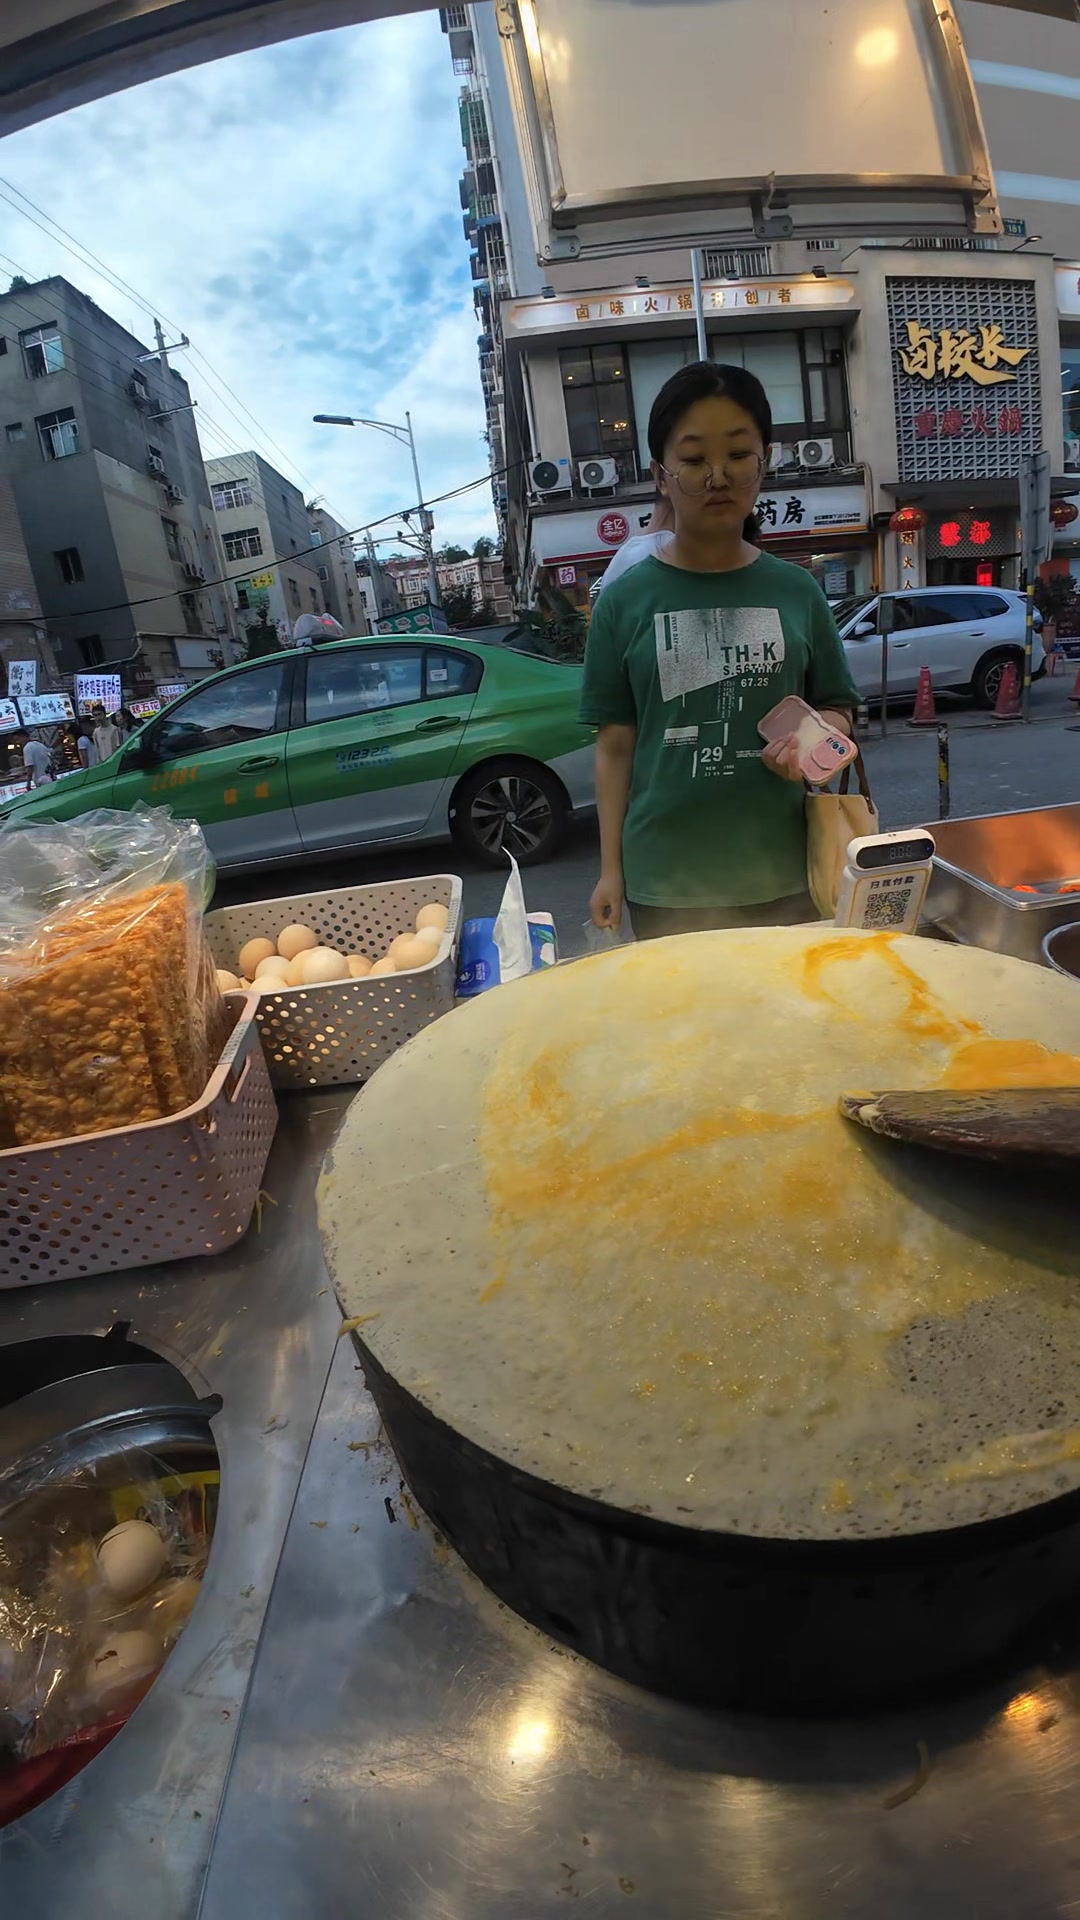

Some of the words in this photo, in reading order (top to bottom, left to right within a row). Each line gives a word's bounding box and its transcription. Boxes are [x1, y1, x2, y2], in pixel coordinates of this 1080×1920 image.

[897, 320, 1033, 386] 卤校长
[561, 568, 574, 583] 药
[721, 642, 777, 663] TH-K
[700, 747, 723, 763] 29
